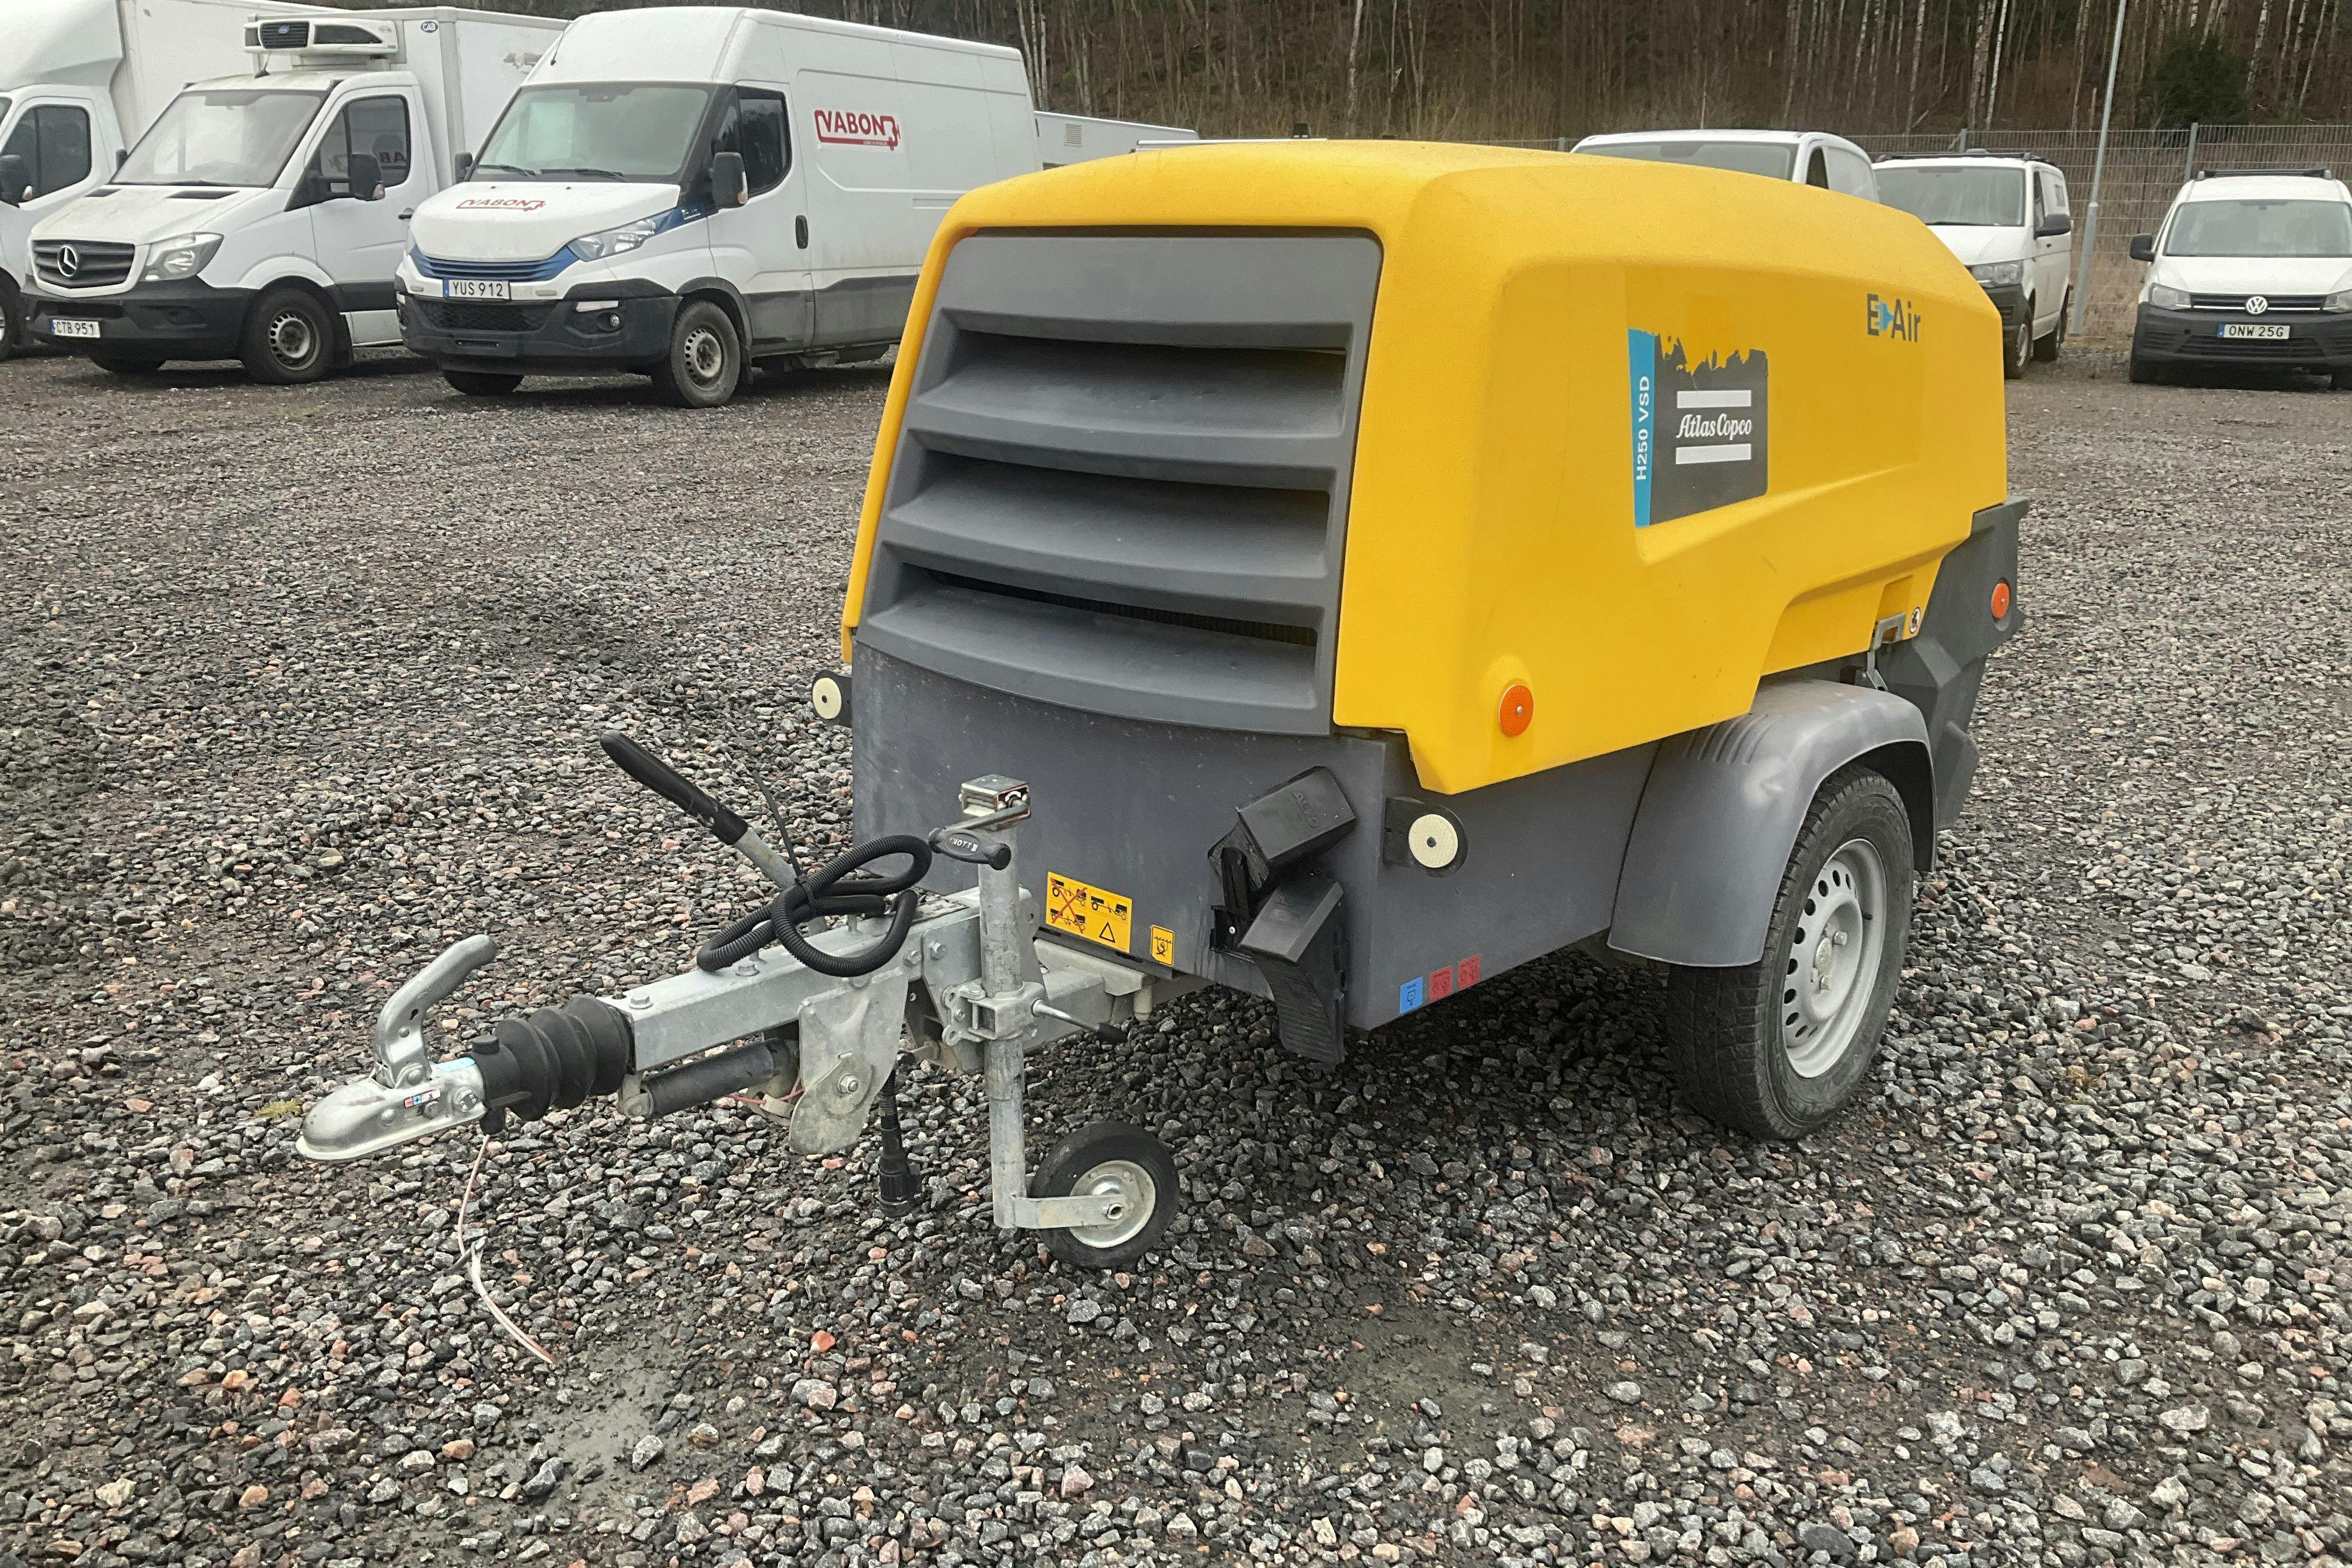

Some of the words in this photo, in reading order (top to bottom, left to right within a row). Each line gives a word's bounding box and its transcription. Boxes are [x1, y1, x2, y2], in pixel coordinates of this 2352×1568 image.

[814, 110, 886, 136] VABON
[453, 281, 474, 296] YUS
[478, 282, 503, 297] 912
[56, 321, 73, 334] CTB
[75, 323, 94, 336] 951
[2229, 326, 2255, 337] ONW
[2258, 326, 2284, 337] 25G
[1638, 376, 1650, 422] VSD
[1636, 428, 1648, 480] H250
